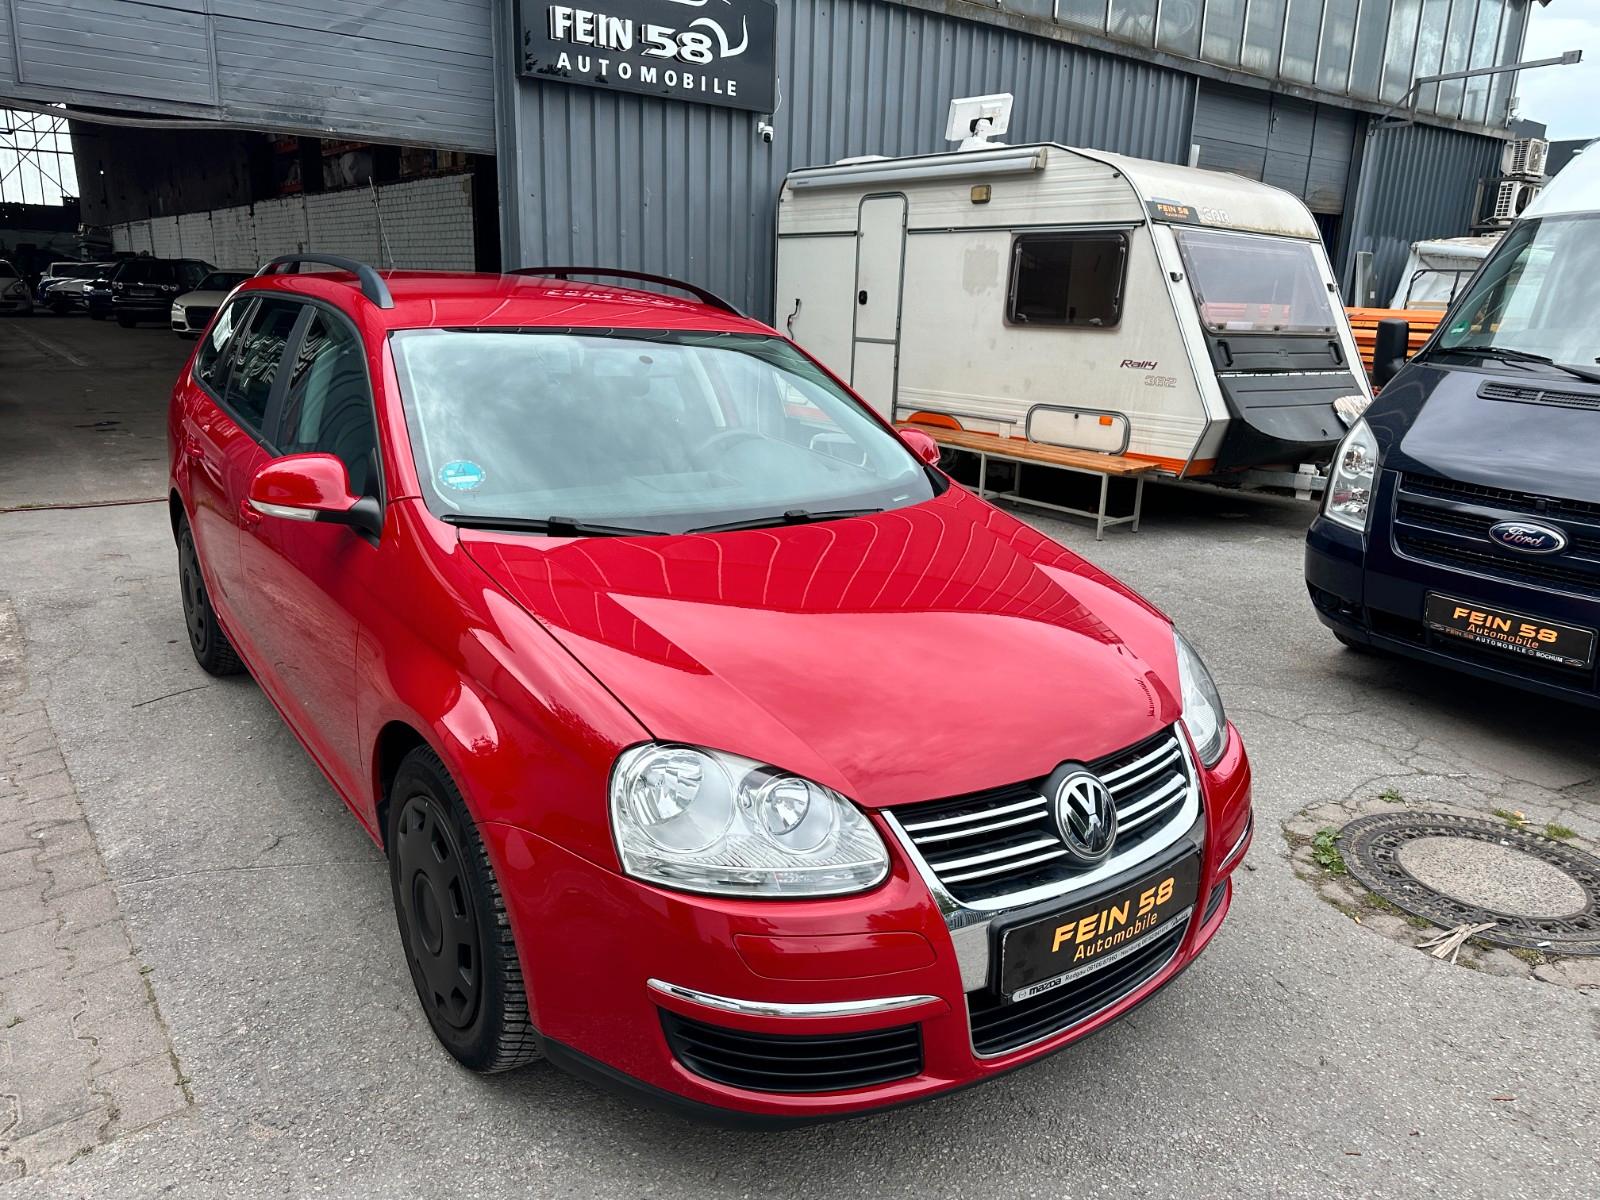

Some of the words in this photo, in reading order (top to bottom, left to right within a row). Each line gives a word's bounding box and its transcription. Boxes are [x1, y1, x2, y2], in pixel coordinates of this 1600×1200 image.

[550, 5, 632, 51] FEIN
[641, 23, 714, 65] 58
[557, 52, 737, 96] AUTOMOBILE
[1120, 359, 1158, 370] Rally
[1503, 526, 1546, 547] Ford
[1453, 606, 1512, 632] FEIN
[1518, 623, 1558, 643] 58
[1467, 624, 1539, 649] Automobile
[1476, 636, 1527, 654] AUTOMOBILE
[1536, 651, 1563, 663] BOCHUM
[1051, 900, 1130, 953] FEIN
[1137, 876, 1175, 917] 58
[1073, 911, 1158, 962] Automobile
